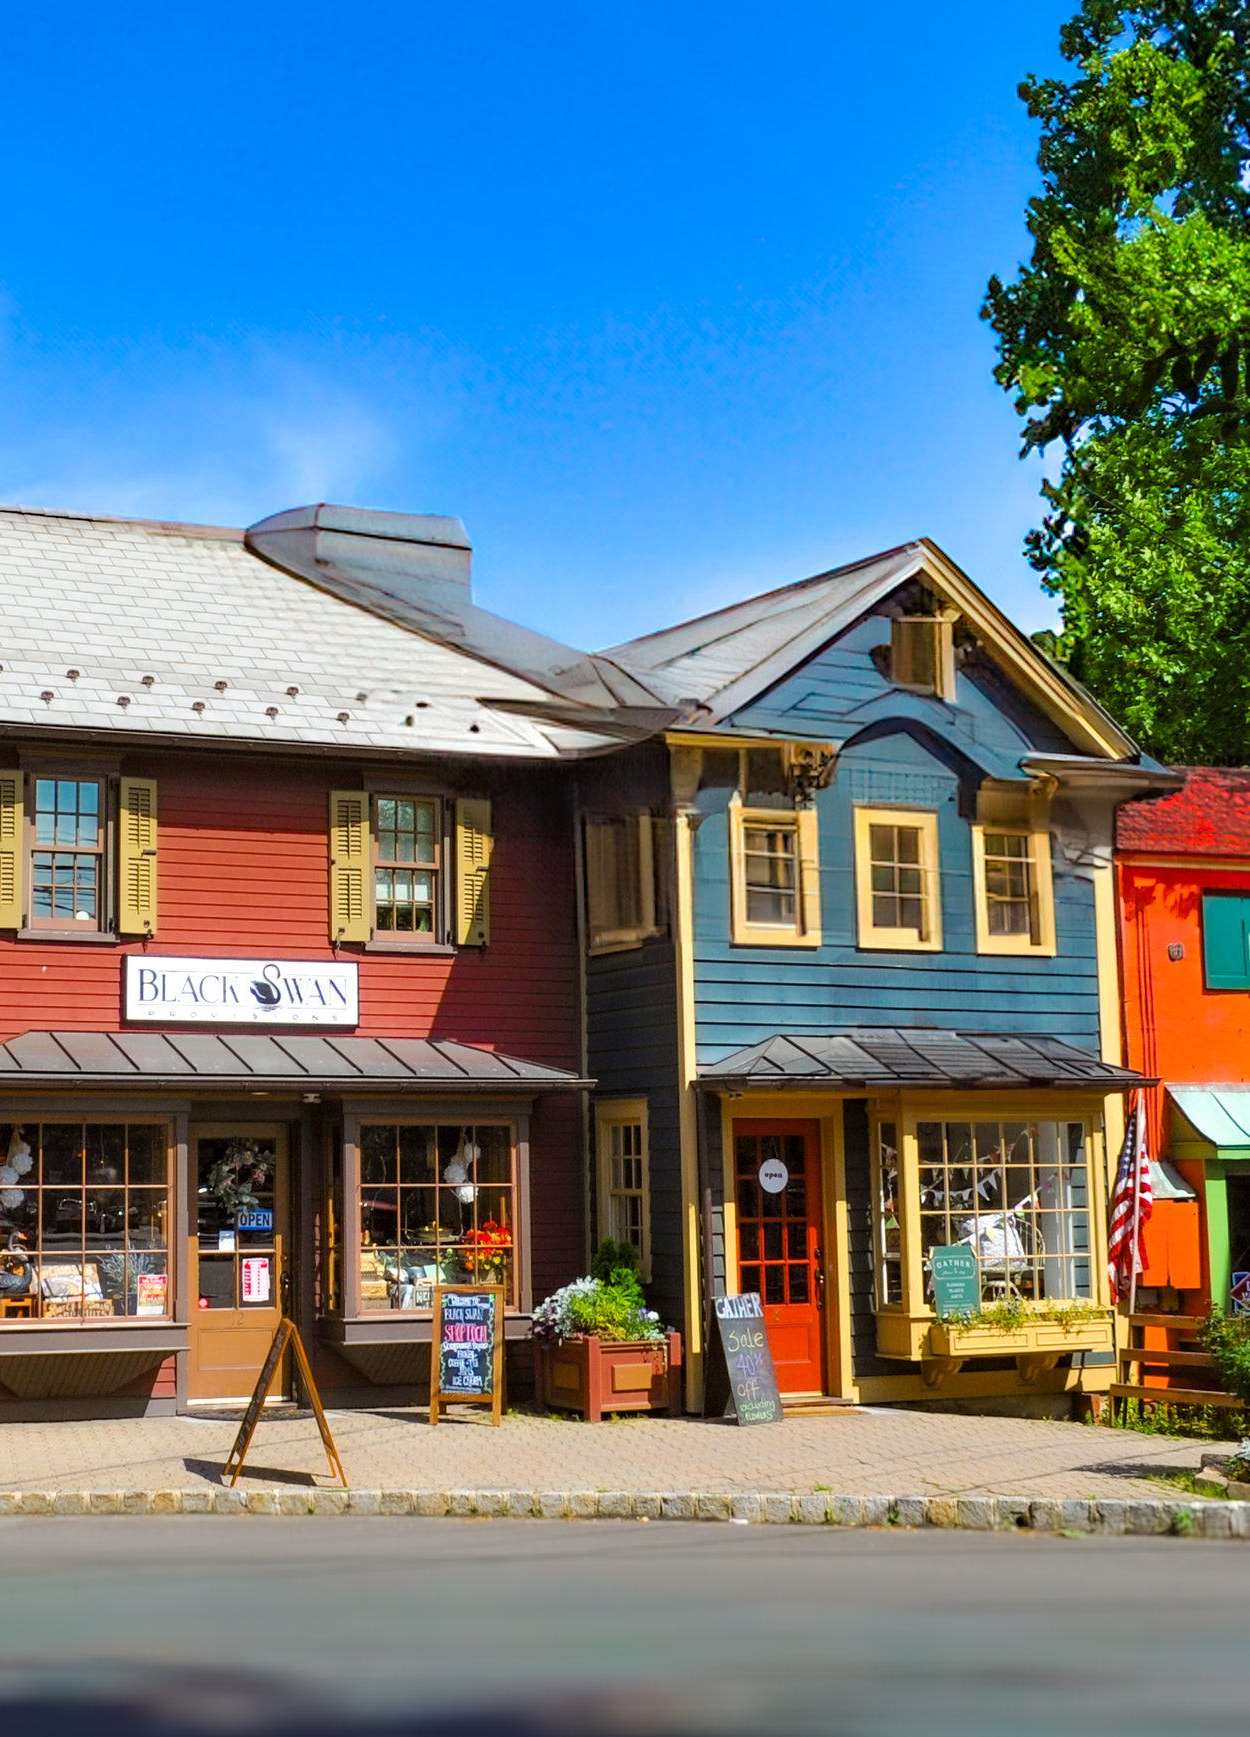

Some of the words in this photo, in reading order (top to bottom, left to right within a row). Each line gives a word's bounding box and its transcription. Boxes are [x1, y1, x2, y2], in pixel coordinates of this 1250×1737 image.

[138, 968, 240, 1004] BLACK
[148, 1010, 338, 1022] PROVISIONS
[764, 1172, 783, 1180] open
[239, 1213, 270, 1226] OPEN
[936, 1259, 971, 1269] GATHER
[716, 1294, 763, 1318] GATHER
[727, 1327, 764, 1352] Sale
[452, 1376, 462, 1386] ICE
